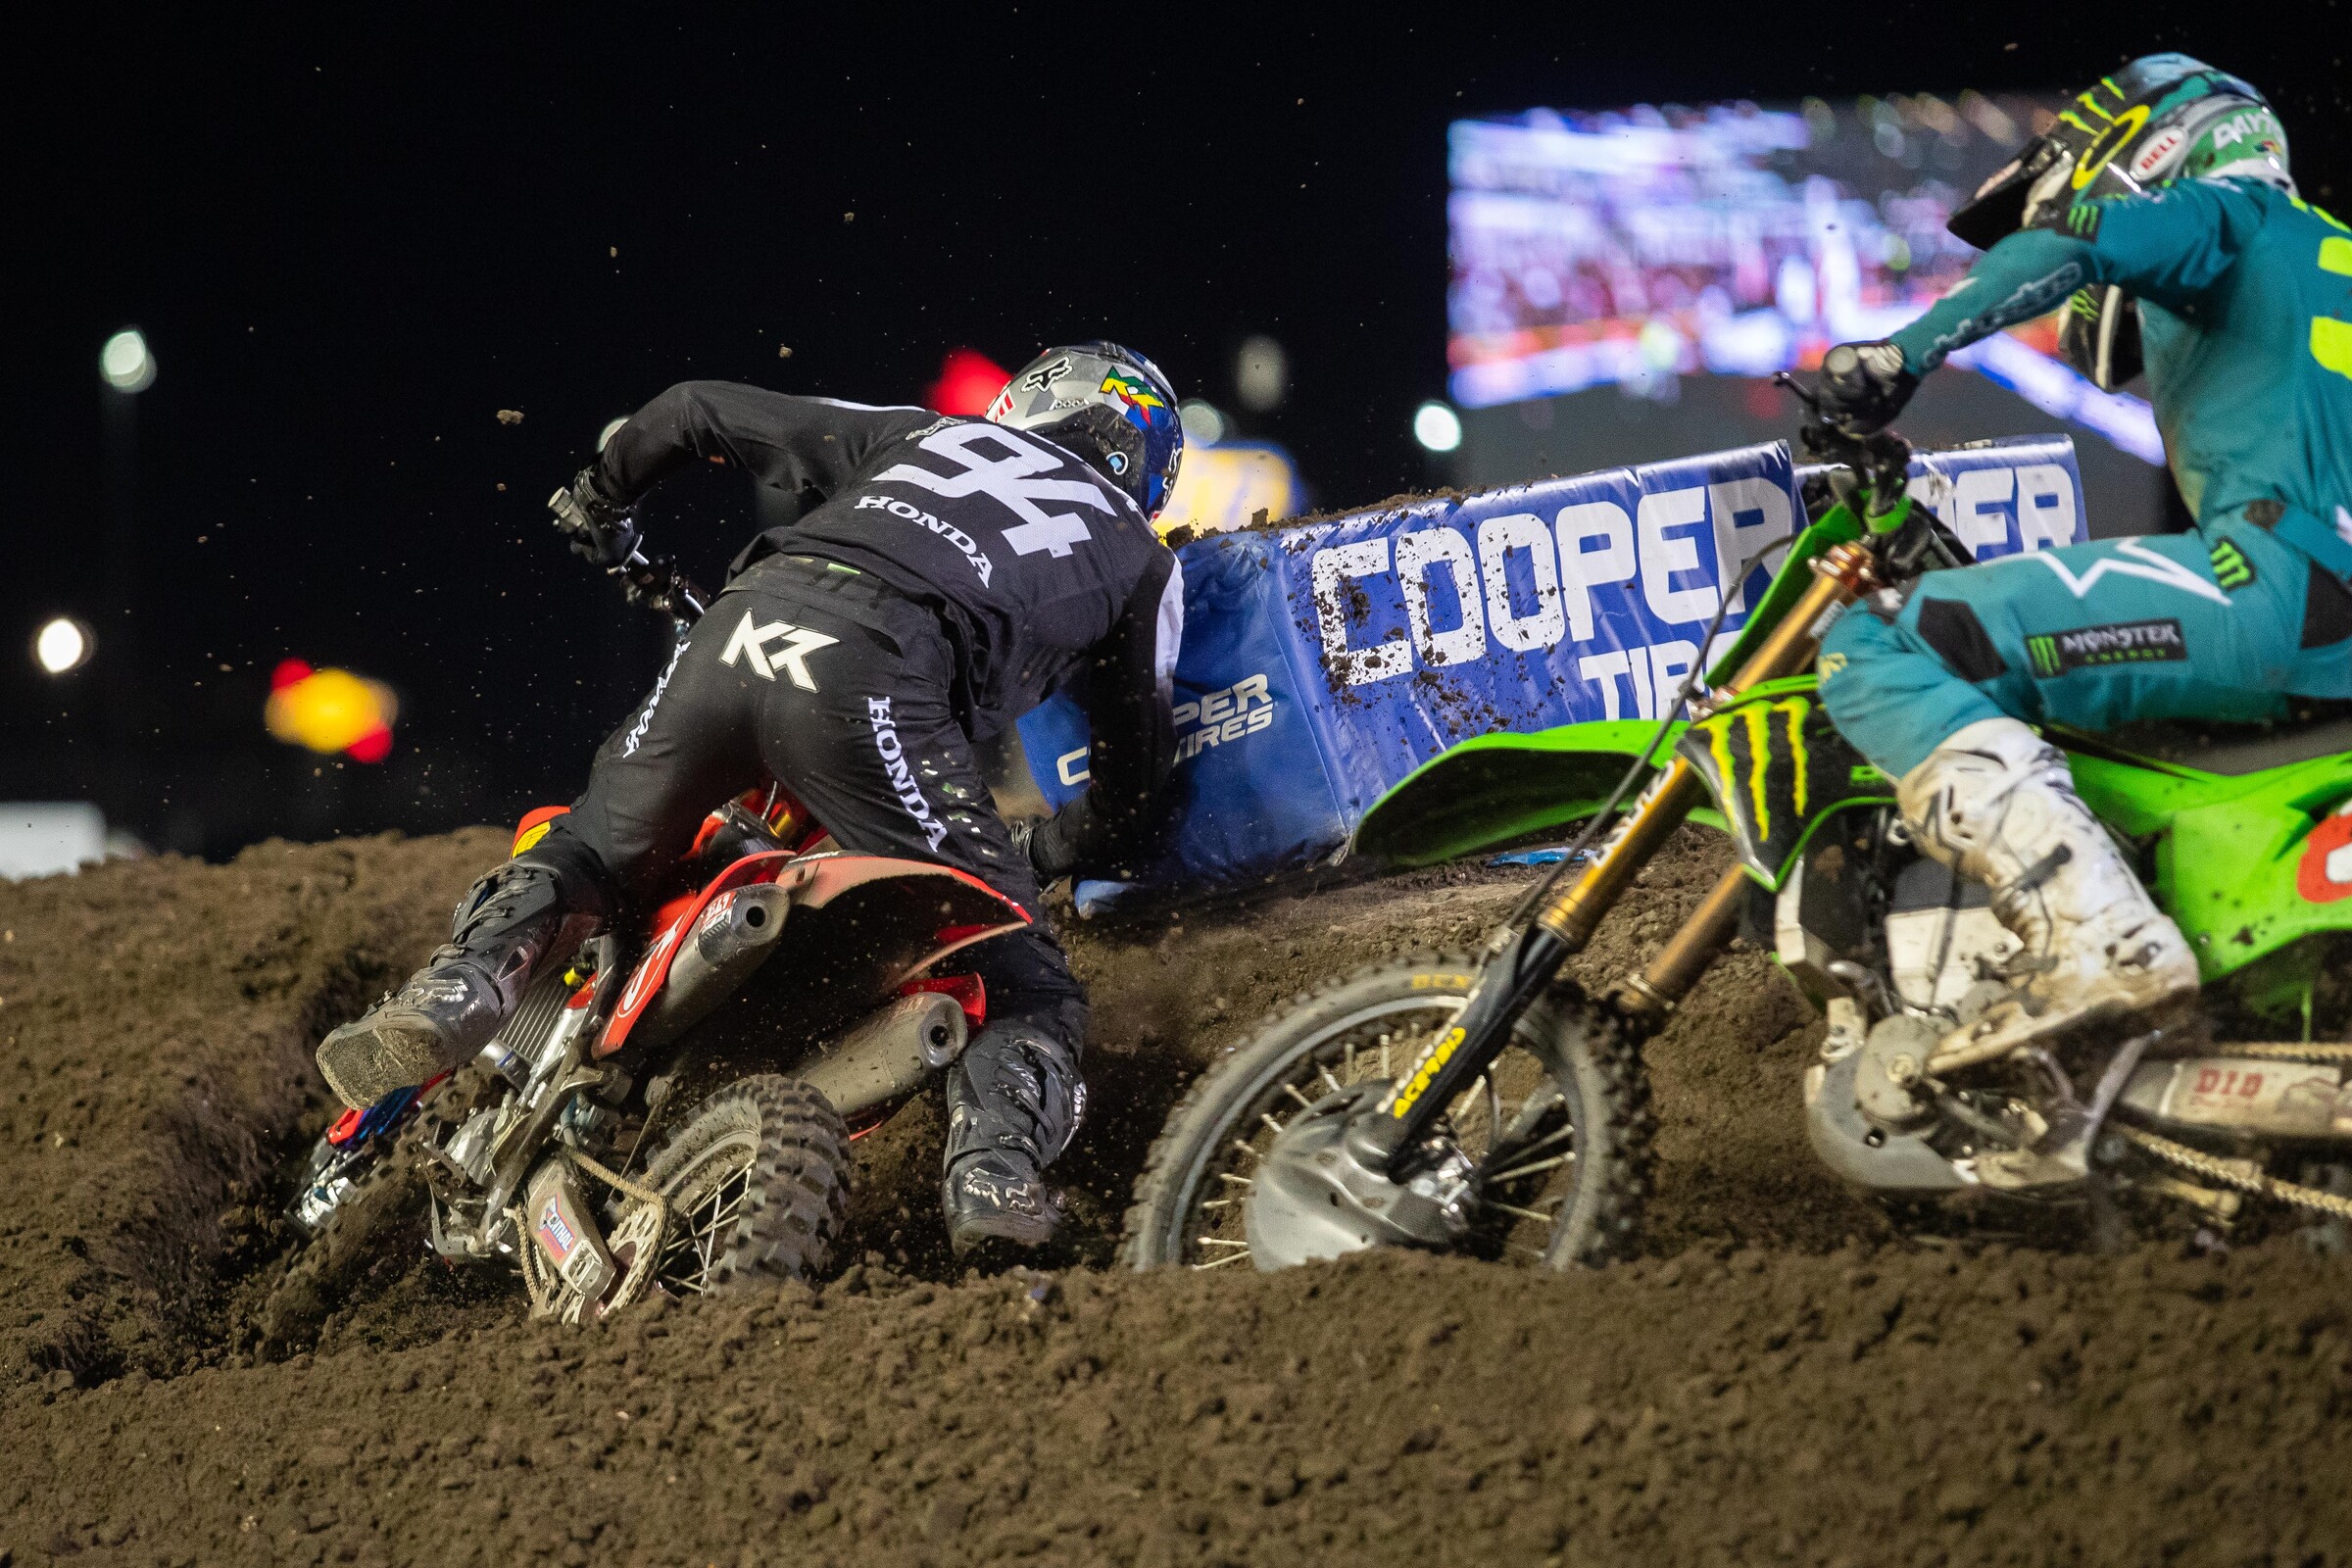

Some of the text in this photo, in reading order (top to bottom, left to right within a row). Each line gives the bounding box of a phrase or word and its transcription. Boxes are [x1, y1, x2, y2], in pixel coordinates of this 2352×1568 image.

[2140, 135, 2178, 170] BELL
[854, 495, 994, 588] HONDA
[1311, 476, 1793, 686] COOPER
[868, 696, 948, 853] HONDA
[1056, 673, 1273, 787] CPER
